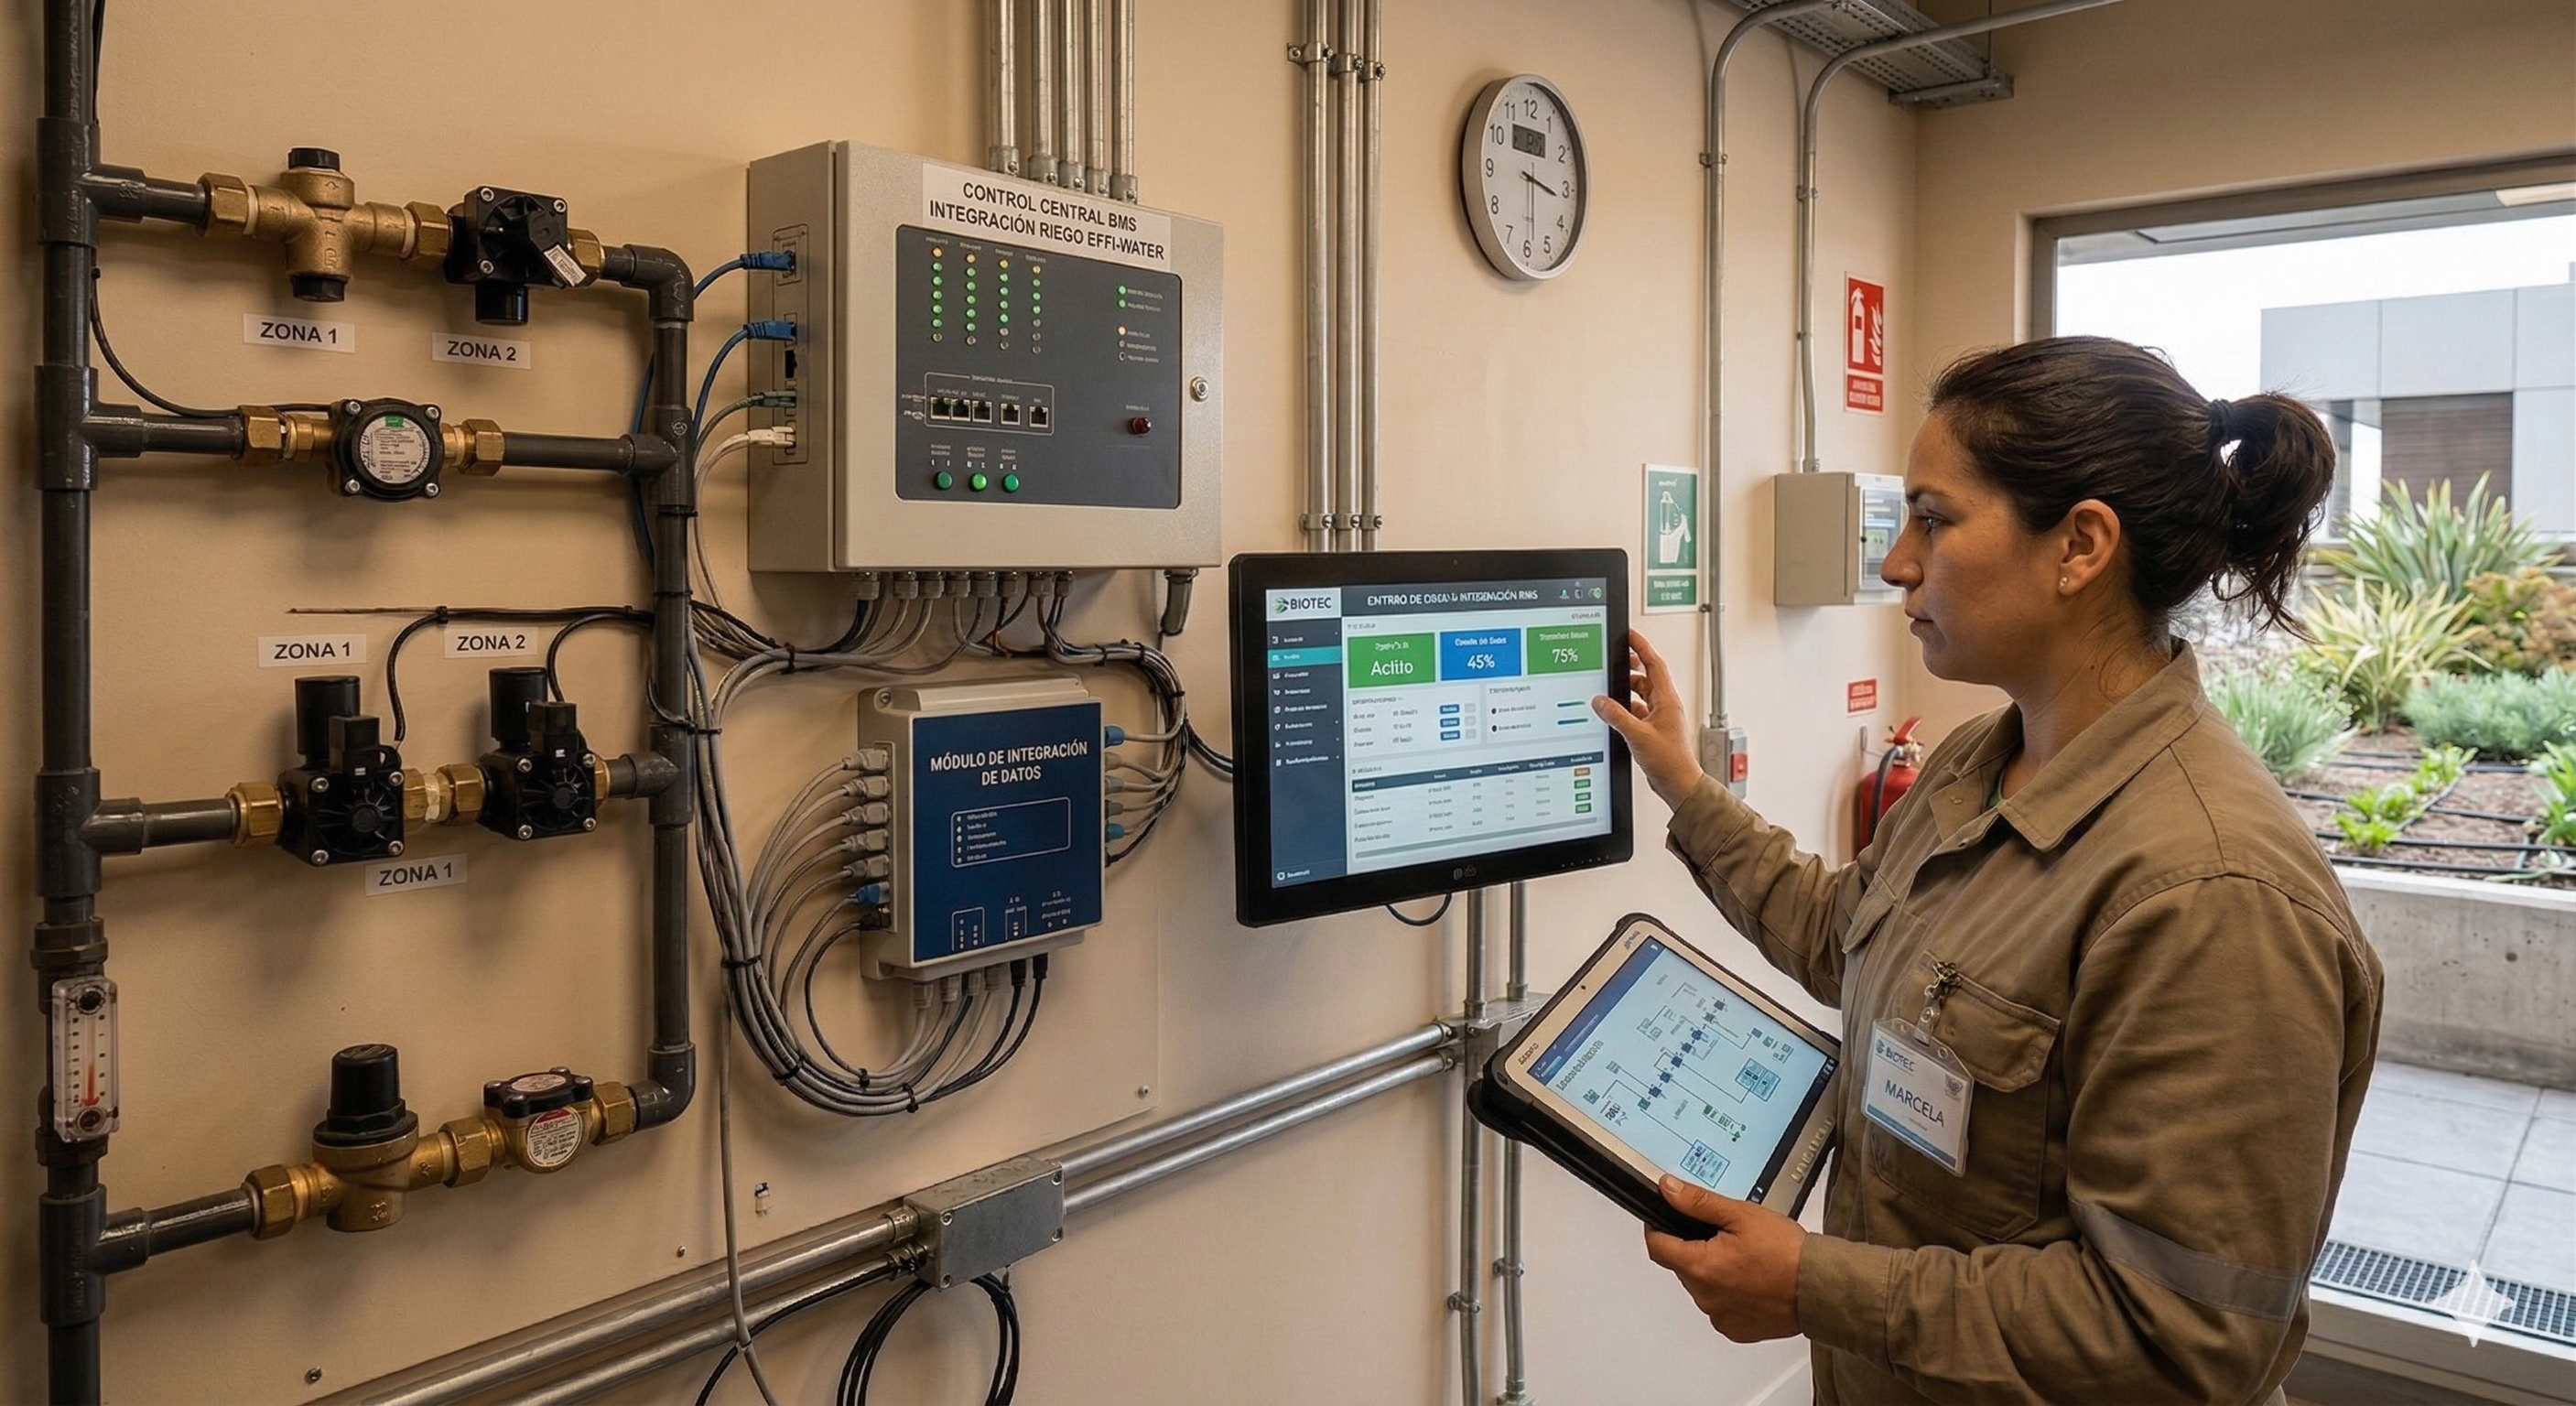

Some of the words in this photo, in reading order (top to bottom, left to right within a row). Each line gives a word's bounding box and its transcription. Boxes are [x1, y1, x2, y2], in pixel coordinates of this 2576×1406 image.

[1504, 101, 1516, 121] 11
[1523, 99, 1538, 120] 12
[1546, 115, 1552, 134] 1
[1489, 124, 1505, 146] 10
[1558, 145, 1566, 164] 2
[1486, 157, 1494, 178] 9
[1562, 180, 1570, 199] 3
[963, 182, 1036, 212] CONTROL
[1040, 199, 1105, 226] CENTRAL
[1109, 215, 1137, 233] BMS
[1490, 195, 1499, 215] 8
[930, 200, 1035, 236] INTEGRACIÓN
[1040, 222, 1084, 244] RIEGO
[1088, 232, 1164, 260] EFFI-WATER
[1556, 214, 1564, 231] 4
[1505, 224, 1514, 244] 7
[1523, 239, 1532, 258] 6
[1543, 235, 1552, 254] 5
[260, 321, 322, 343] ZONA
[328, 328, 338, 344] 1
[447, 341, 502, 362] ZONA
[505, 346, 517, 362] 2
[1289, 597, 1332, 611] BIOTEC
[1410, 594, 1423, 605] DE
[274, 643, 336, 660] ZONA
[341, 642, 351, 657] 1
[456, 635, 511, 652] ZONA
[515, 634, 525, 649] 2
[1467, 654, 1495, 670] 45%
[1552, 648, 1578, 664] 75%
[930, 751, 986, 772] MÓDULO
[989, 750, 1005, 765] DE
[1007, 739, 1088, 763] INTEGRACIÓN
[981, 771, 999, 786] DE
[1001, 765, 1042, 784] DATOS
[379, 864, 438, 887] ZONA
[443, 862, 452, 878] 1
[1885, 1079, 1944, 1128] MARCELA
